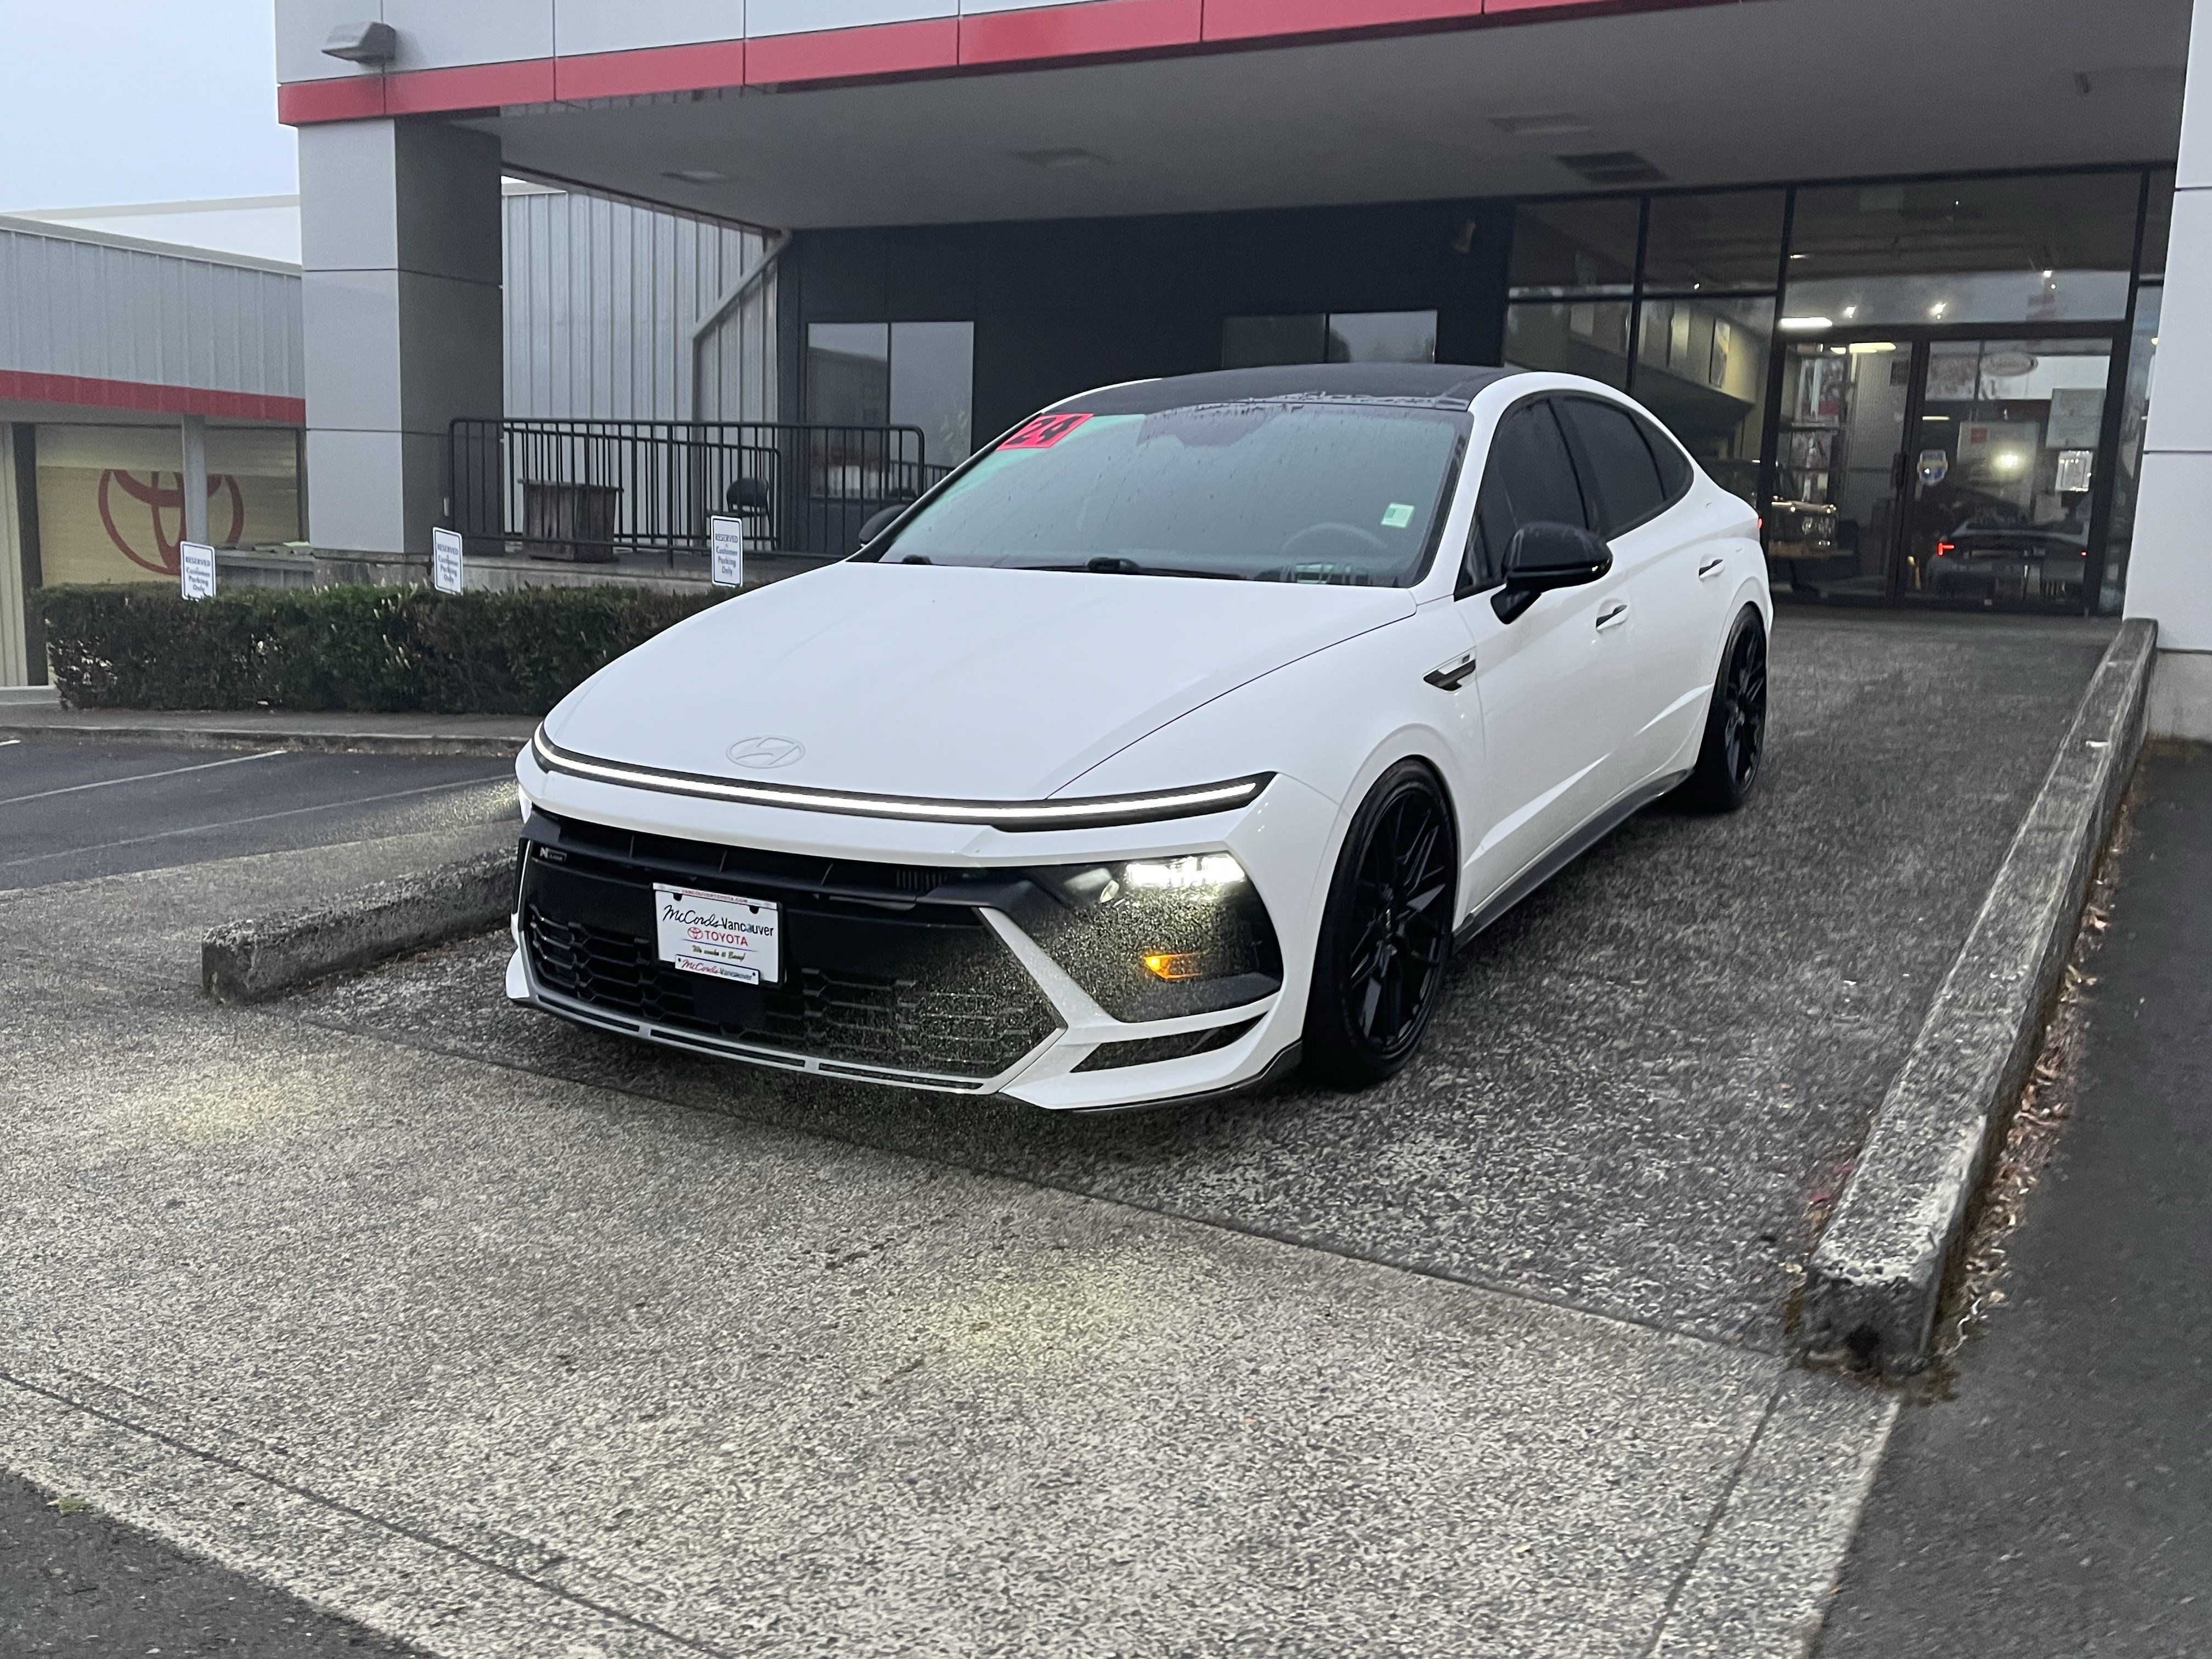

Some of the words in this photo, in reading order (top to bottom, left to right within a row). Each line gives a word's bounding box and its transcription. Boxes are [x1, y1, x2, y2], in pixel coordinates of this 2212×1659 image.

[1005, 416, 1083, 445] 24
[715, 533, 738, 543] RESERVED
[437, 544, 459, 555] RESERVED
[185, 556, 210, 566] RESERVED
[722, 566, 732, 577] Only
[704, 930, 748, 946] TOYOTA
